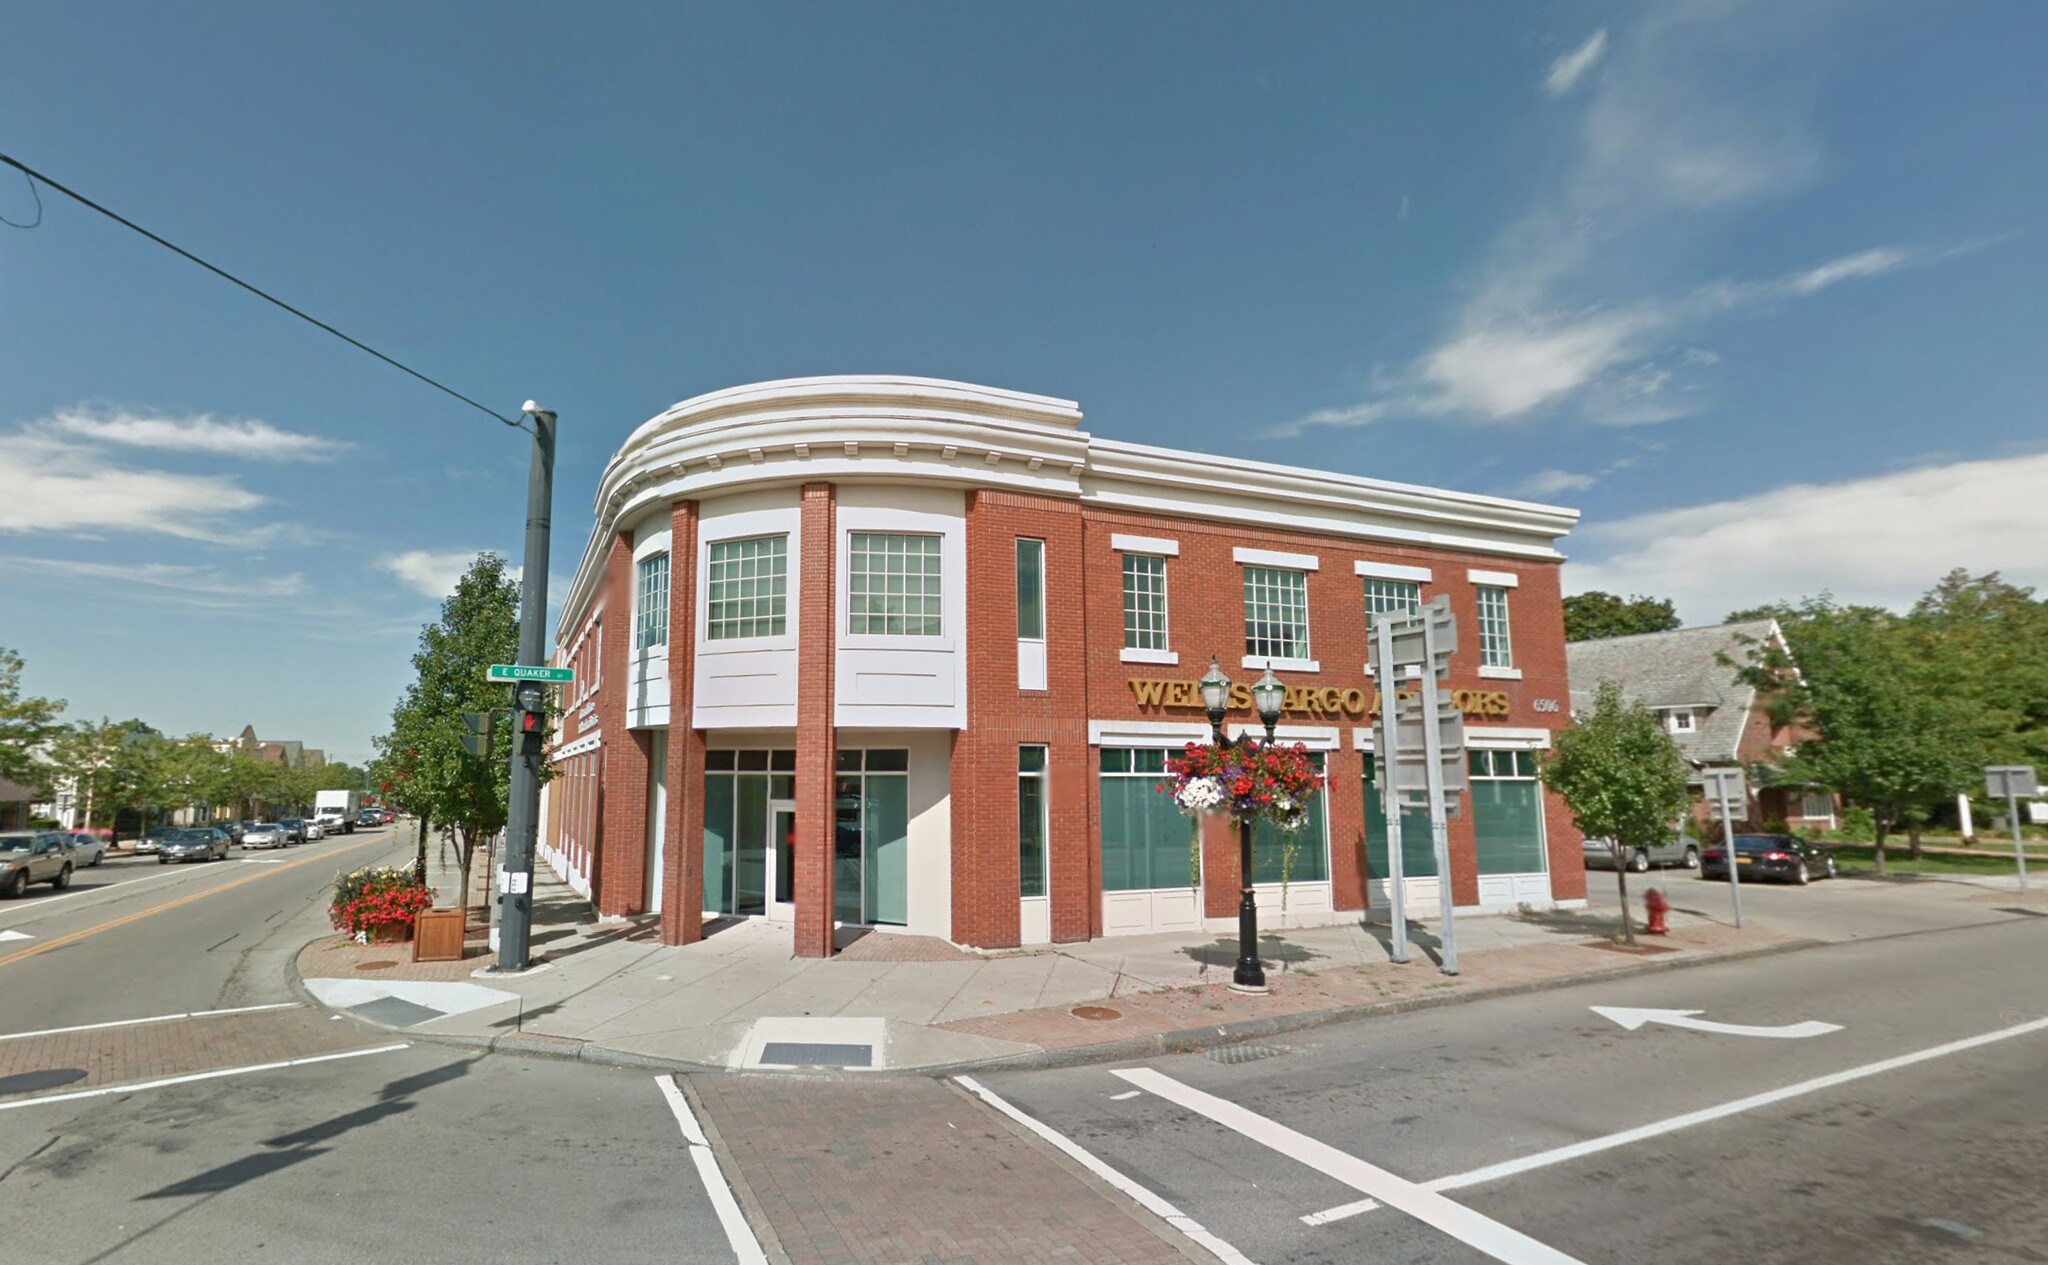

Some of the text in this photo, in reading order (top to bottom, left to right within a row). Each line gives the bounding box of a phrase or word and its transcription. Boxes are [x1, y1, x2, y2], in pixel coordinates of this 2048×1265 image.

[502, 668, 508, 676] E
[513, 668, 551, 678] QUAKER
[1128, 679, 1253, 709] WELS
[1264, 685, 1365, 714] ARGO
